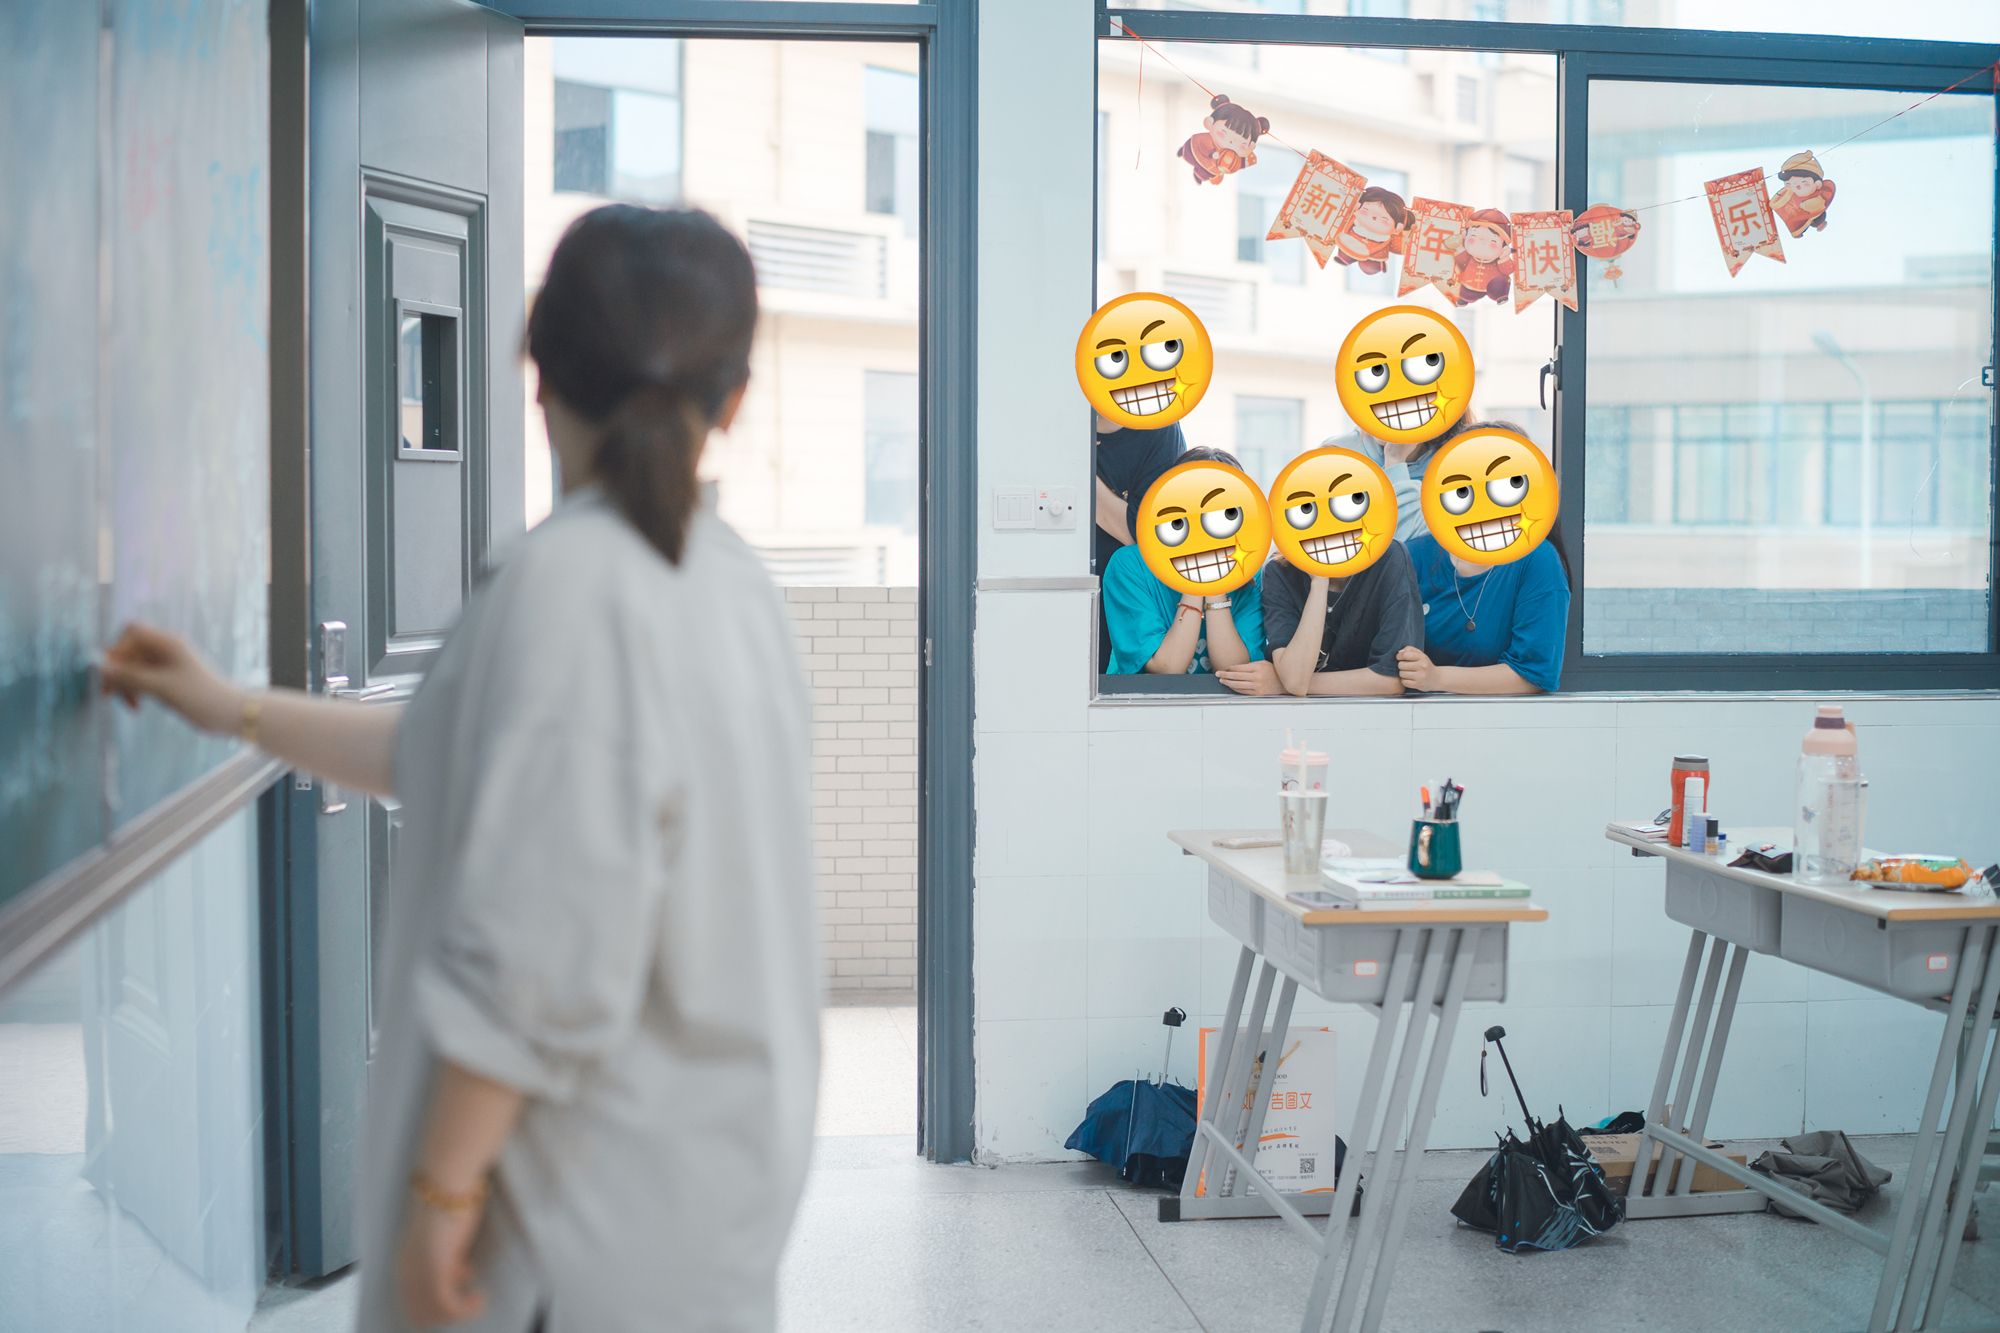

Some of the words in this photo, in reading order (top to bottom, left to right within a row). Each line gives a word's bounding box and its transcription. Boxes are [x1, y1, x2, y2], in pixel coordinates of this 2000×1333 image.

[1301, 184, 1341, 225] 新
[1419, 223, 1457, 261] 年
[1527, 240, 1561, 276] 快
[1728, 199, 1762, 237] 乐
